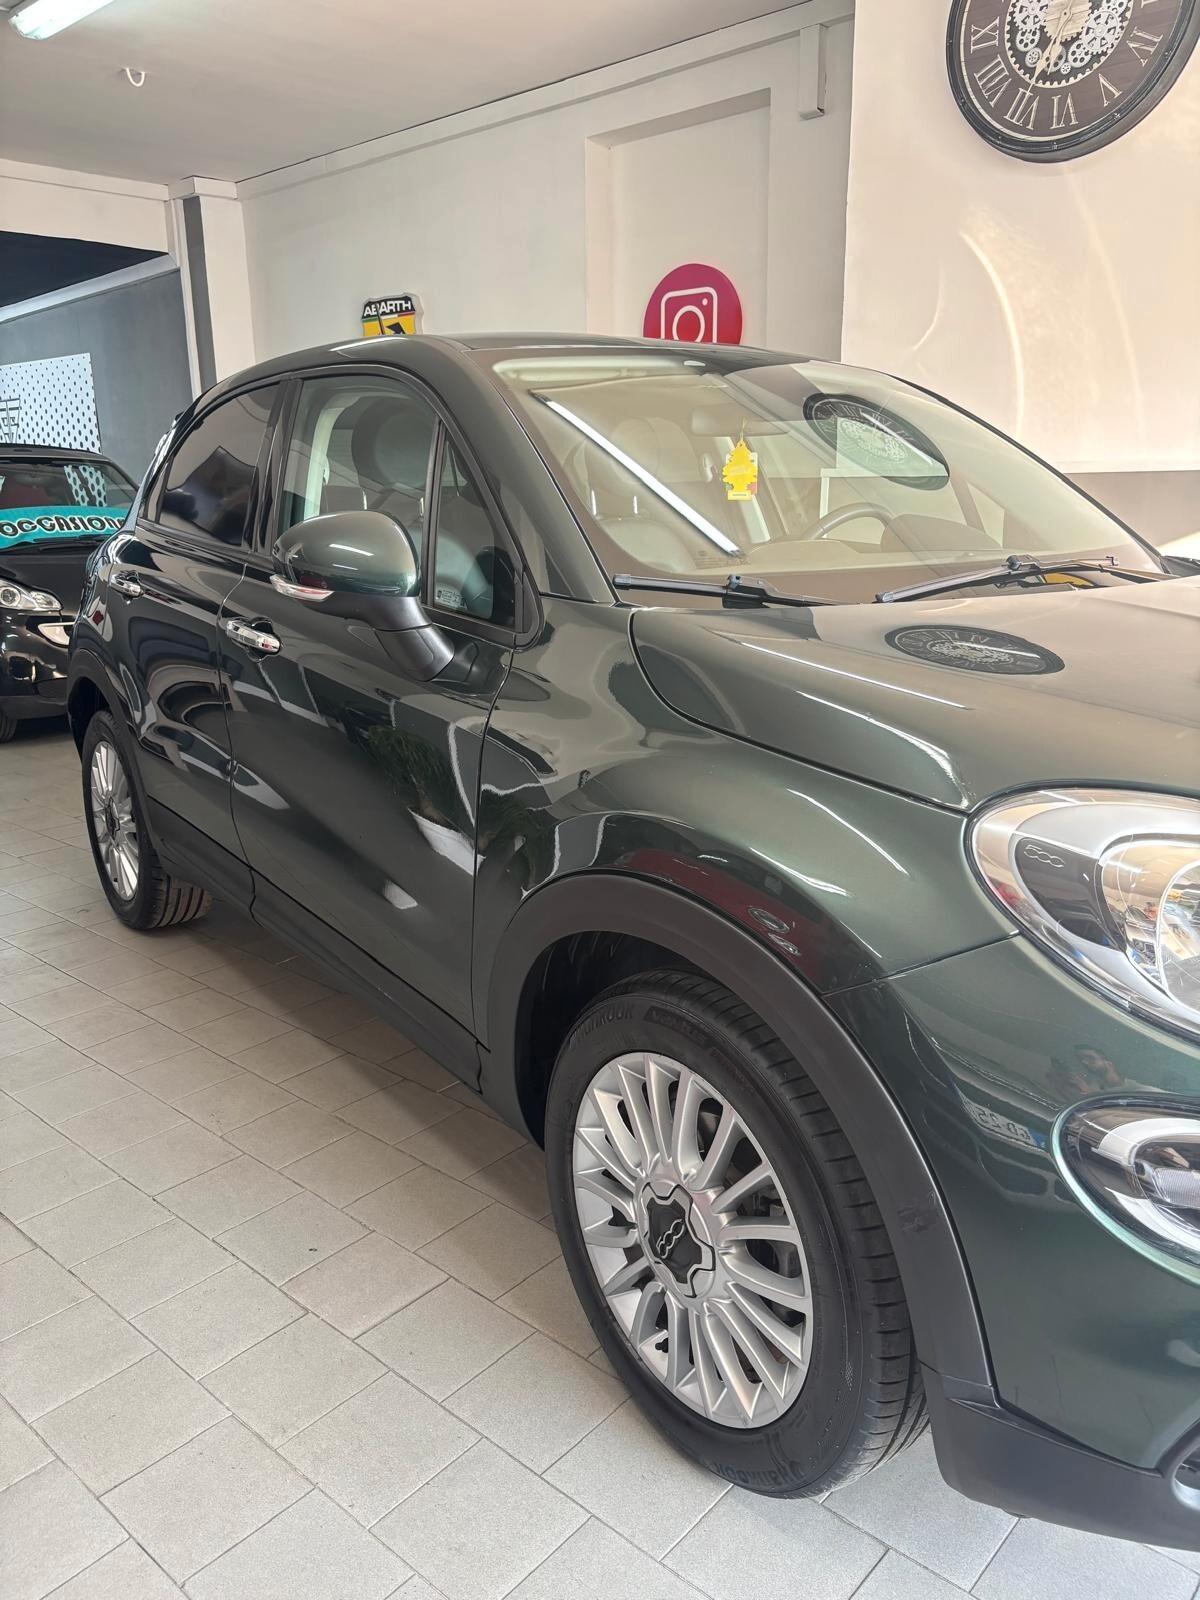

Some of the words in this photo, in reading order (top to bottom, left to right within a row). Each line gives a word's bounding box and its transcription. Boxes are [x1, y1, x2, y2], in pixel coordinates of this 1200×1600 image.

[971, 16, 999, 54] IX
[1126, 26, 1163, 67] IV
[974, 54, 1012, 108] VIII
[1099, 73, 1122, 107] V
[1003, 87, 1039, 130] VII
[1050, 92, 1079, 129] VI
